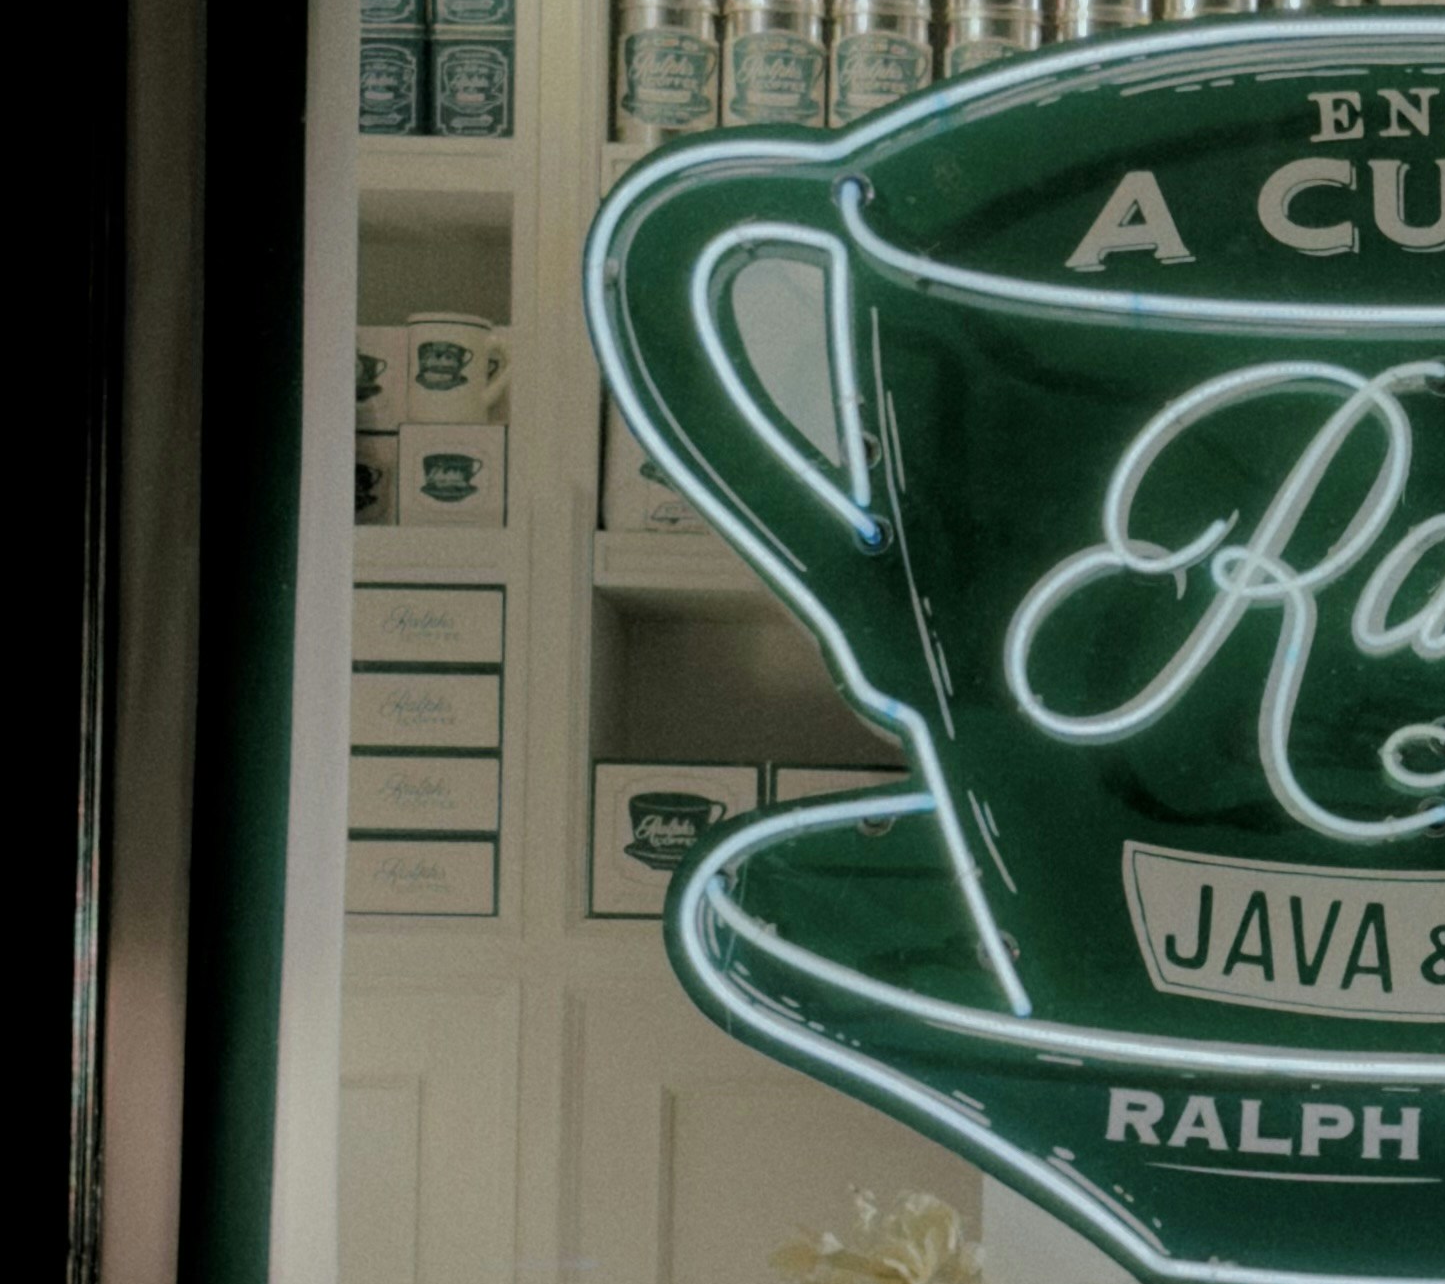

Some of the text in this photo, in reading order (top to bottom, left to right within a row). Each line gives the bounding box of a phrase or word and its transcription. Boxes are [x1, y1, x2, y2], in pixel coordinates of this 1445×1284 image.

[1063, 169, 1197, 273] A
[1165, 884, 1395, 995] JAVA
[1104, 1086, 1422, 1163] RALPH
